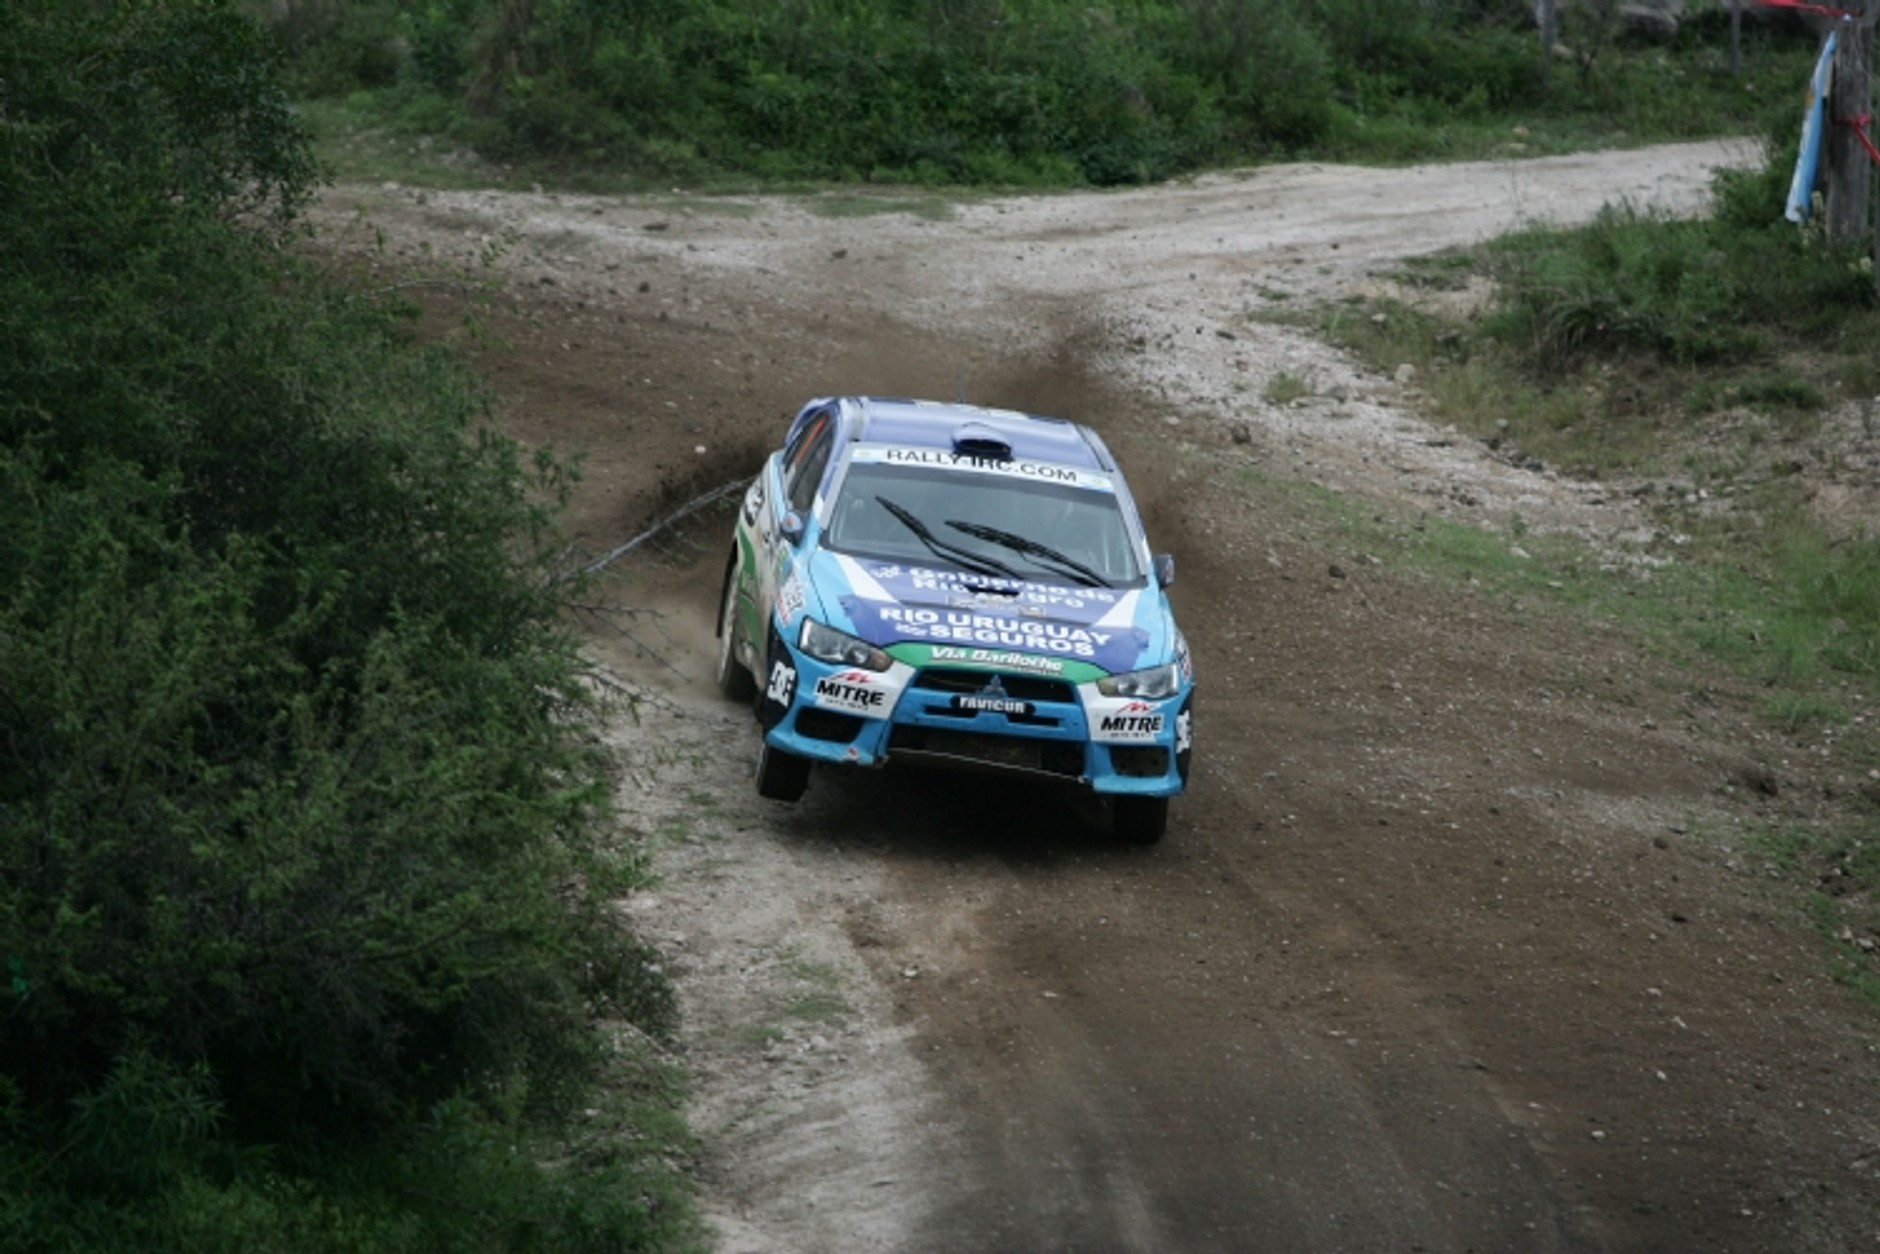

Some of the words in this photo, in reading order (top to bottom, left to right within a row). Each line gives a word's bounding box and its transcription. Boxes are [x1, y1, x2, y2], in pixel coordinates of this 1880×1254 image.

[1075, 588, 1116, 603] de
[879, 608, 939, 625] RIO
[947, 612, 1112, 647] URUGUAY
[929, 627, 1095, 657] SEGUROS
[972, 649, 1064, 671] Bariloche
[816, 680, 885, 706] MITRE
[1100, 716, 1162, 733] MITRE
